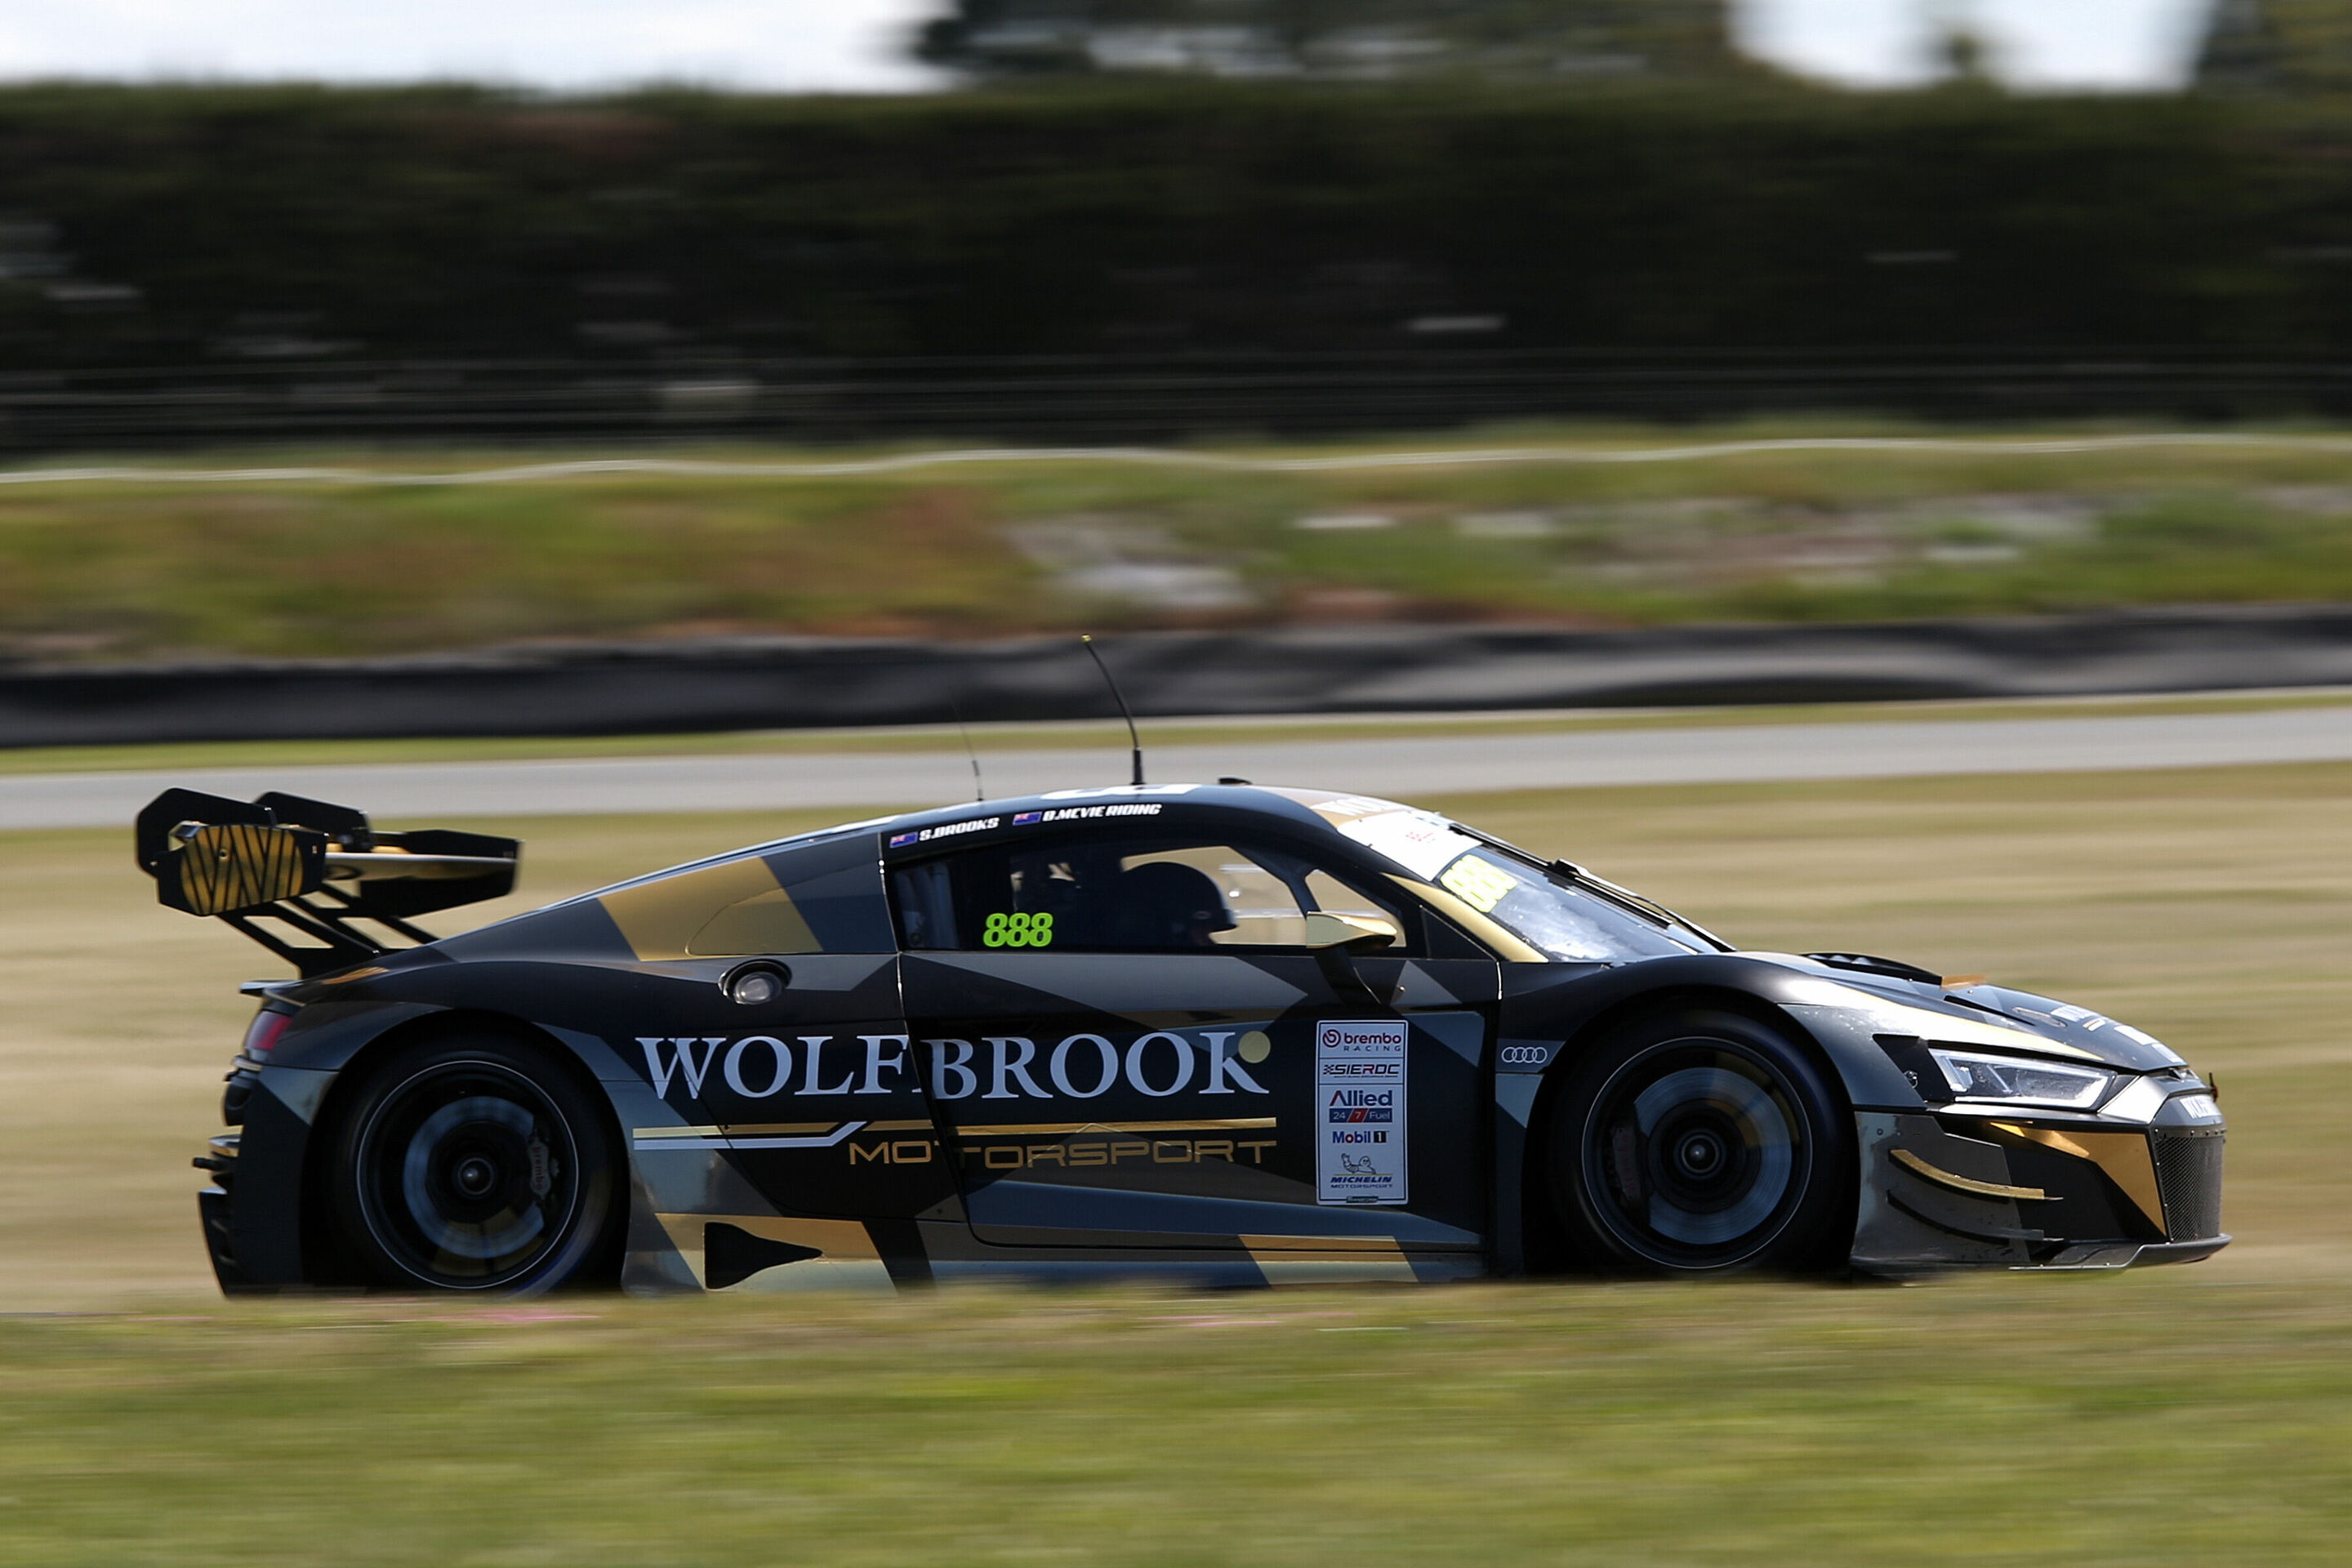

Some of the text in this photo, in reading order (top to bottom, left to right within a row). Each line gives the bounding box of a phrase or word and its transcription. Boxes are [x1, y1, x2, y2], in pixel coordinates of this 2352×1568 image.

[1106, 804, 1162, 817] RIDING
[919, 817, 1000, 841] S.BROOKS
[982, 912, 1054, 947] 888
[1344, 1032, 1401, 1044] brembo
[635, 1031, 1271, 1101] WOLFBROOK
[1330, 1064, 1400, 1075] SIERDC
[1330, 1090, 1392, 1106] Allied
[1369, 1111, 1390, 1120] Fuel
[1333, 1131, 1370, 1143] Mobil
[849, 1139, 1278, 1169] MOTORSPORT
